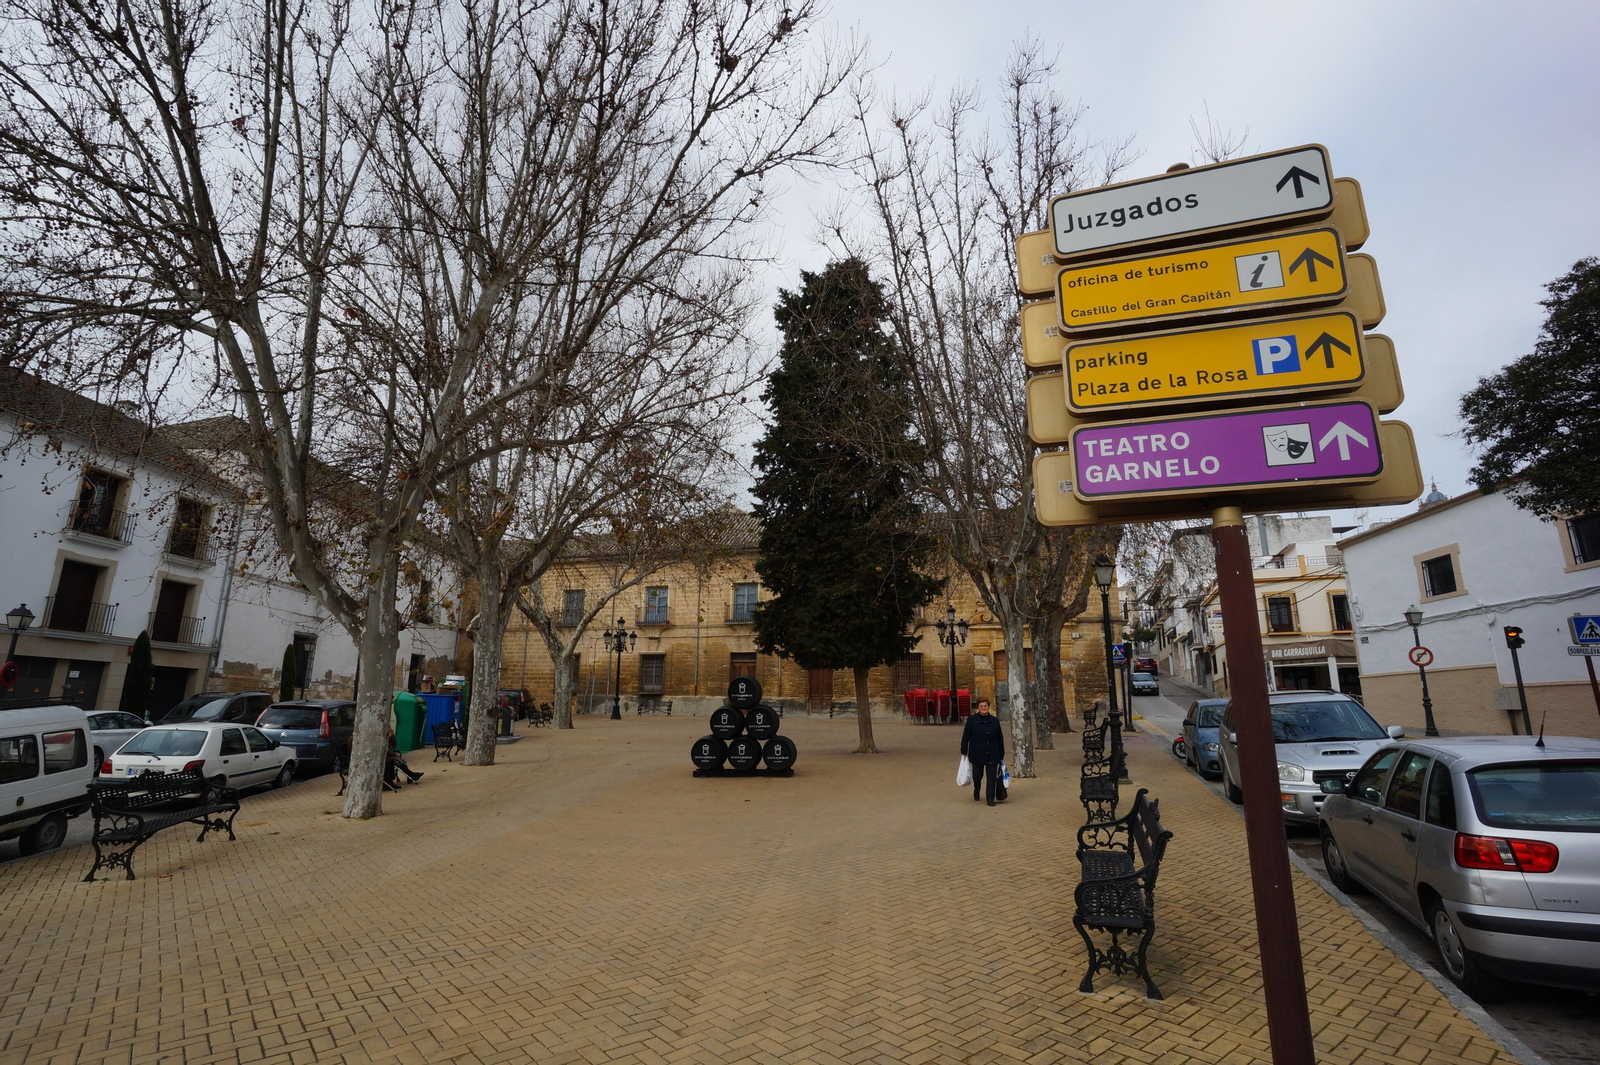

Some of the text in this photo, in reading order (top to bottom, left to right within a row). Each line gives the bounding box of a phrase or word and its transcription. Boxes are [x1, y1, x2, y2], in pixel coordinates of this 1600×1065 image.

[1063, 193, 1199, 234] Juzgados
[1068, 260, 1209, 288] oficina de turismo
[1070, 289, 1231, 318] Castillo del Gran Capitán
[1075, 351, 1148, 372] parking
[1258, 337, 1292, 374] P
[1078, 369, 1248, 397] Plaza de la Rosa
[1083, 432, 1190, 457] TEATRO
[1085, 455, 1220, 483] GARNELO
[1271, 649, 1283, 658] BAR
[1283, 645, 1326, 657] CARRASQUILLA
